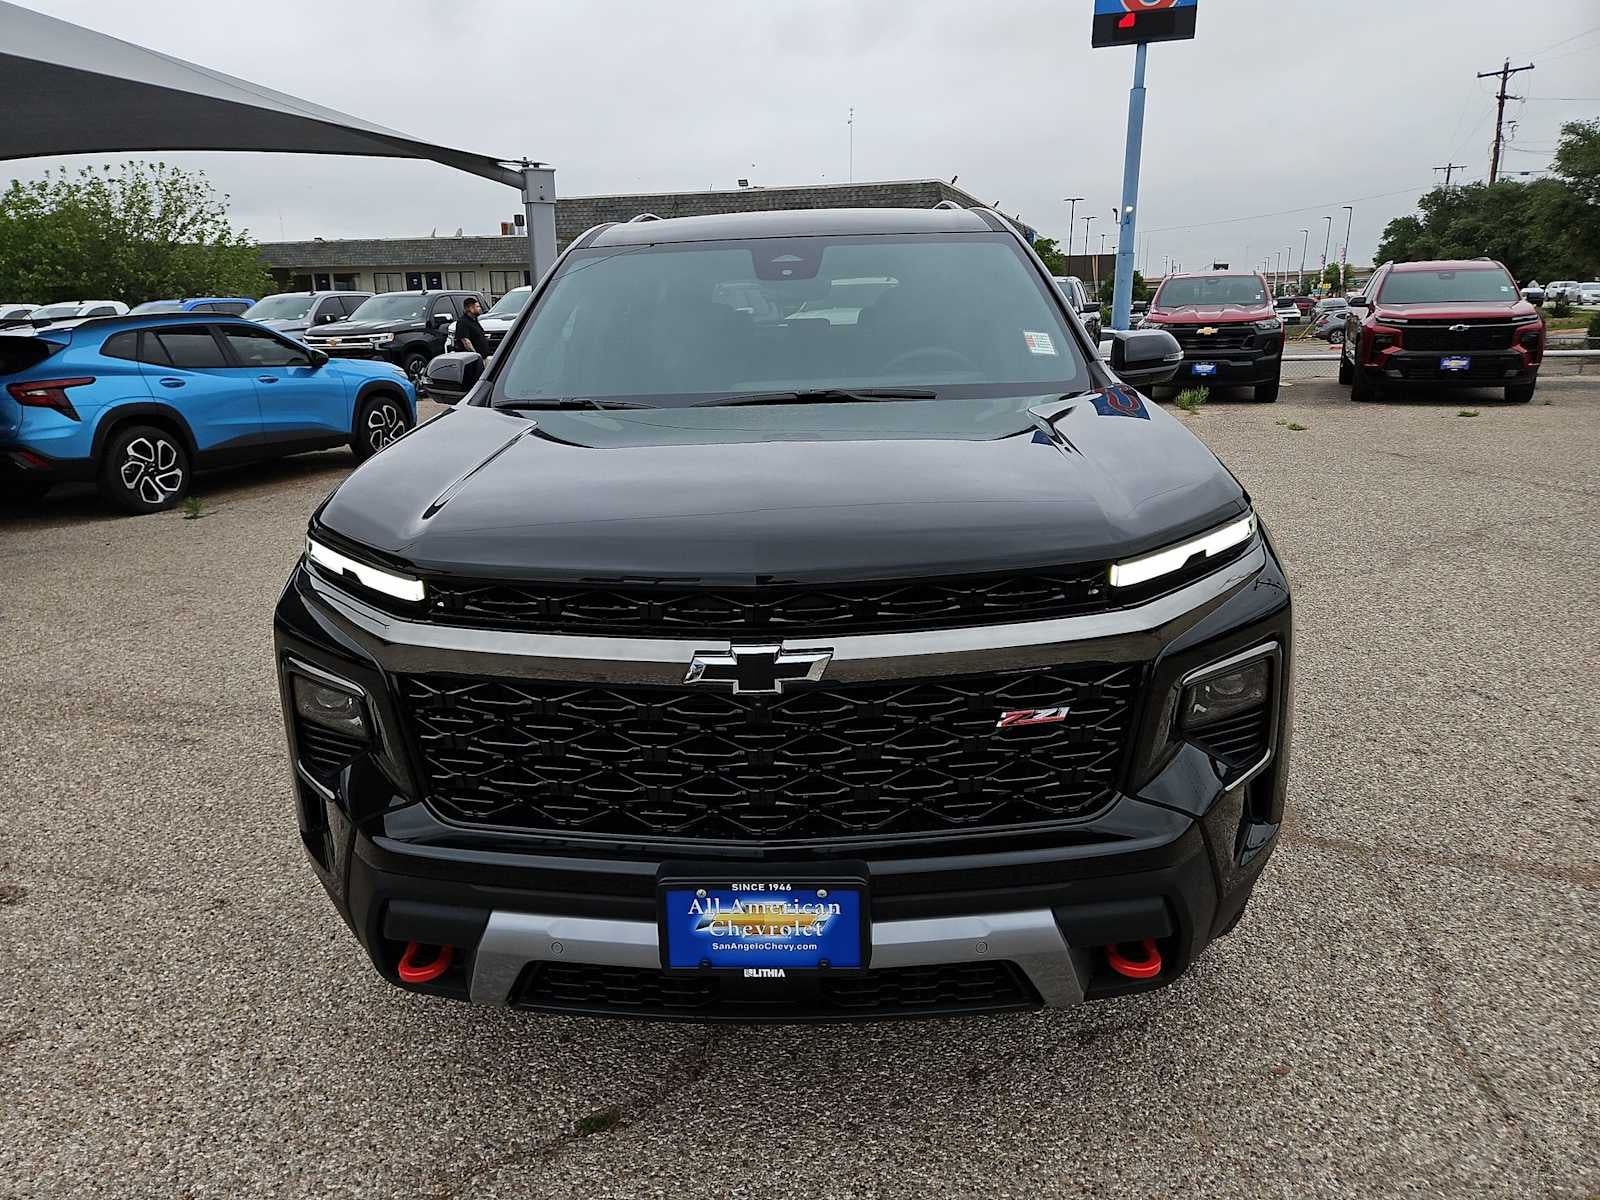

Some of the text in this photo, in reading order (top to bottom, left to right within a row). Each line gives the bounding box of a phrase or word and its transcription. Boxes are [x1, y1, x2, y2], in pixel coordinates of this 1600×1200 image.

[996, 707, 1070, 728] Z71
[731, 883, 792, 891] SINCE 1946
[687, 898, 841, 915] All American
[709, 920, 823, 937] Chevrolet
[712, 942, 817, 951] SanAngeloChevy.com
[753, 968, 786, 978] LITHIA
